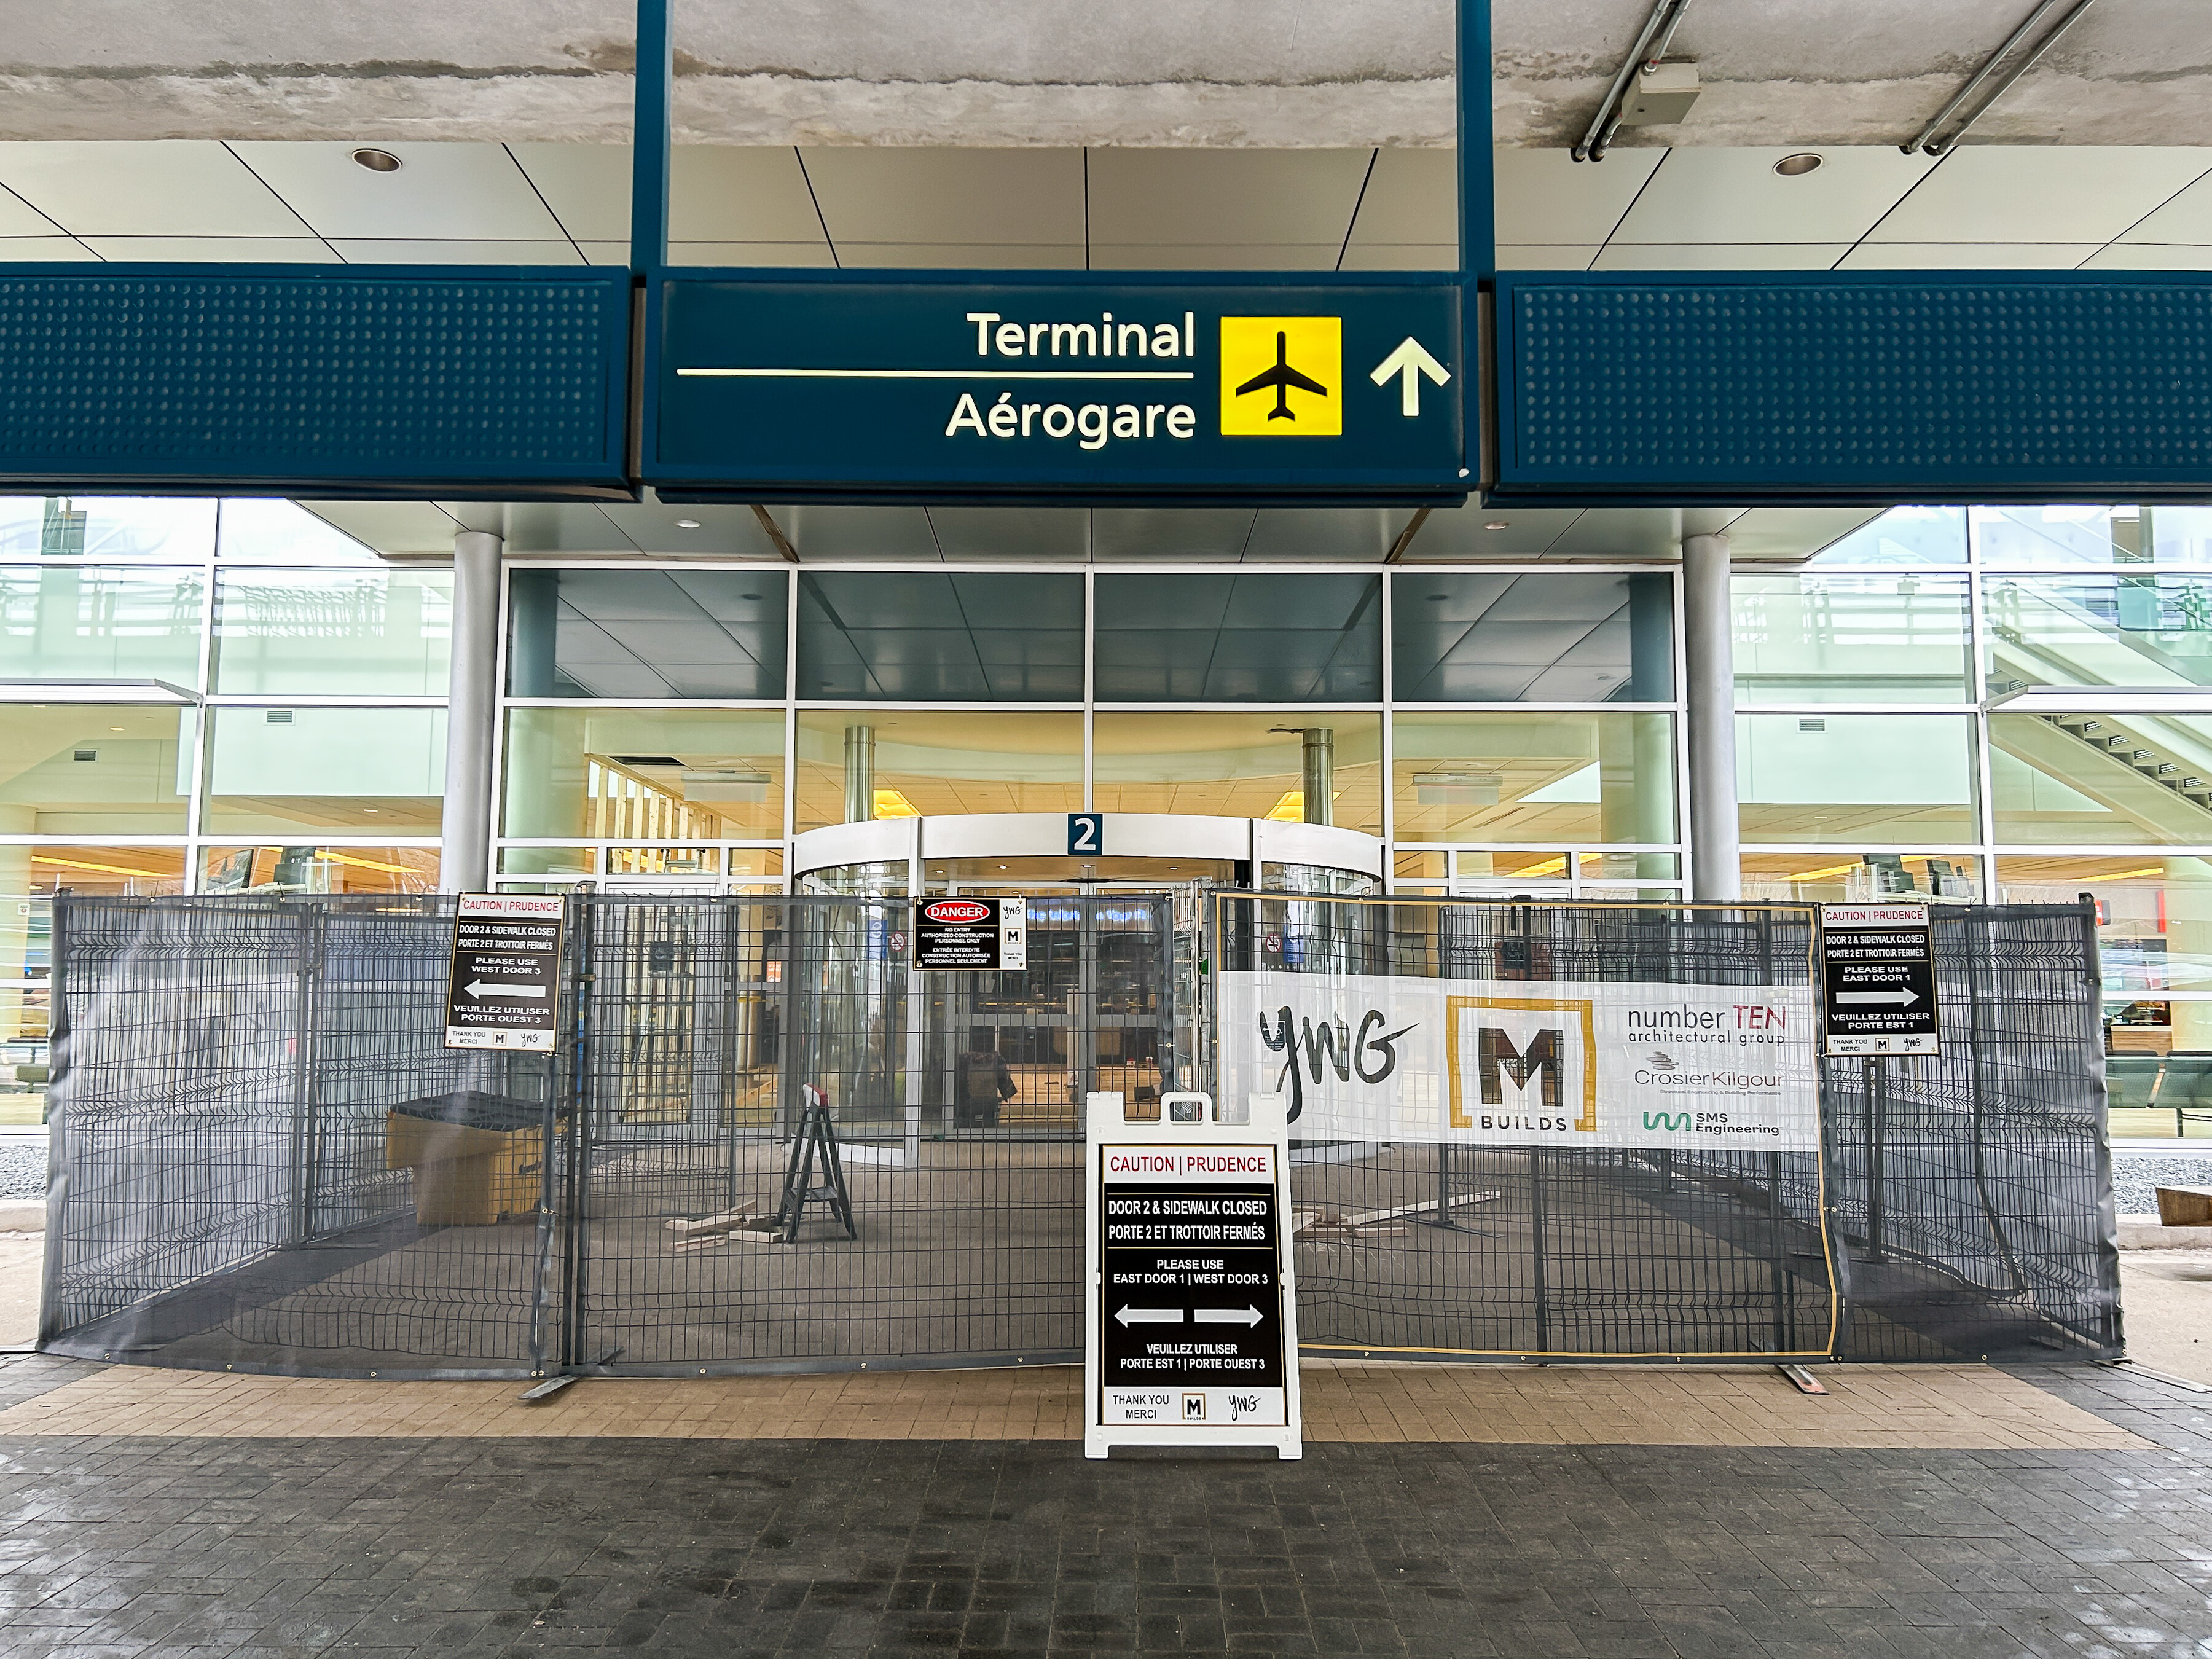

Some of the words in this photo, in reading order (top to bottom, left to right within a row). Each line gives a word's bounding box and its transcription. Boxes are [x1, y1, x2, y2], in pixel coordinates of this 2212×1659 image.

[967, 312, 1193, 356] Terminal
[946, 393, 1195, 449] Aérogare
[1074, 818, 1096, 850] 2
[464, 901, 502, 909] CAUTION
[509, 901, 559, 911] PRUDENCE
[931, 907, 984, 917] DANGER
[1826, 911, 1865, 920] CAUTION
[1874, 911, 1923, 920] PRUDENCE
[459, 925, 479, 934] DOOR
[492, 926, 527, 935] SIDEWALK
[528, 927, 556, 936] CLOSED
[1008, 931, 1018, 941] M
[458, 939, 479, 947] PORTE
[495, 940, 525, 949] TROTTOIR
[527, 940, 552, 950] FERMÉS
[1860, 935, 1896, 944] SIDEWALK
[1897, 947, 1924, 957] FERMÉS
[1629, 1003, 1725, 1028] number
[1733, 1005, 1786, 1030] TEN
[1629, 1030, 1730, 1043] architectural
[1740, 1035, 1784, 1046] group
[1478, 1028, 1564, 1107] M
[1481, 1116, 1566, 1131] BUILDS
[1696, 1113, 1728, 1123] SMS
[1696, 1123, 1779, 1136] Engineering
[1111, 1157, 1174, 1171] CAUTION
[1188, 1157, 1266, 1172] PRUDENCE
[1109, 1201, 1140, 1214] DOOR
[1143, 1201, 1150, 1214] 2
[1153, 1201, 1160, 1214] &
[1163, 1201, 1220, 1214] SIDEWALK
[1222, 1201, 1266, 1215] CLOSED
[1109, 1225, 1143, 1239] PORTE
[1146, 1225, 1151, 1239] 2
[1155, 1226, 1167, 1239] ET
[1169, 1225, 1220, 1239] TROTTOIR
[1223, 1222, 1265, 1239] FERMÉS
[1157, 1260, 1199, 1269] PLEASE
[1202, 1260, 1223, 1269] USE
[1114, 1274, 1142, 1283] EAST
[1145, 1274, 1176, 1283] DOOR
[1179, 1274, 1184, 1283] 1
[1193, 1274, 1225, 1283] WEST
[1228, 1274, 1259, 1284] DOOR
[1262, 1274, 1268, 1284] 3
[1147, 1344, 1193, 1354] VEUILLEZ
[1194, 1344, 1237, 1354] UTILISER
[1121, 1359, 1153, 1368] PORTE
[1156, 1359, 1174, 1368] EST
[1177, 1359, 1180, 1368] 1
[1190, 1359, 1222, 1368] PORTE
[1225, 1359, 1257, 1369] OUEST
[1259, 1359, 1265, 1369] 3
[1113, 1395, 1146, 1404] THANK
[1149, 1395, 1169, 1404] YOU
[1187, 1398, 1201, 1414] M
[1126, 1410, 1156, 1419] MERCI
